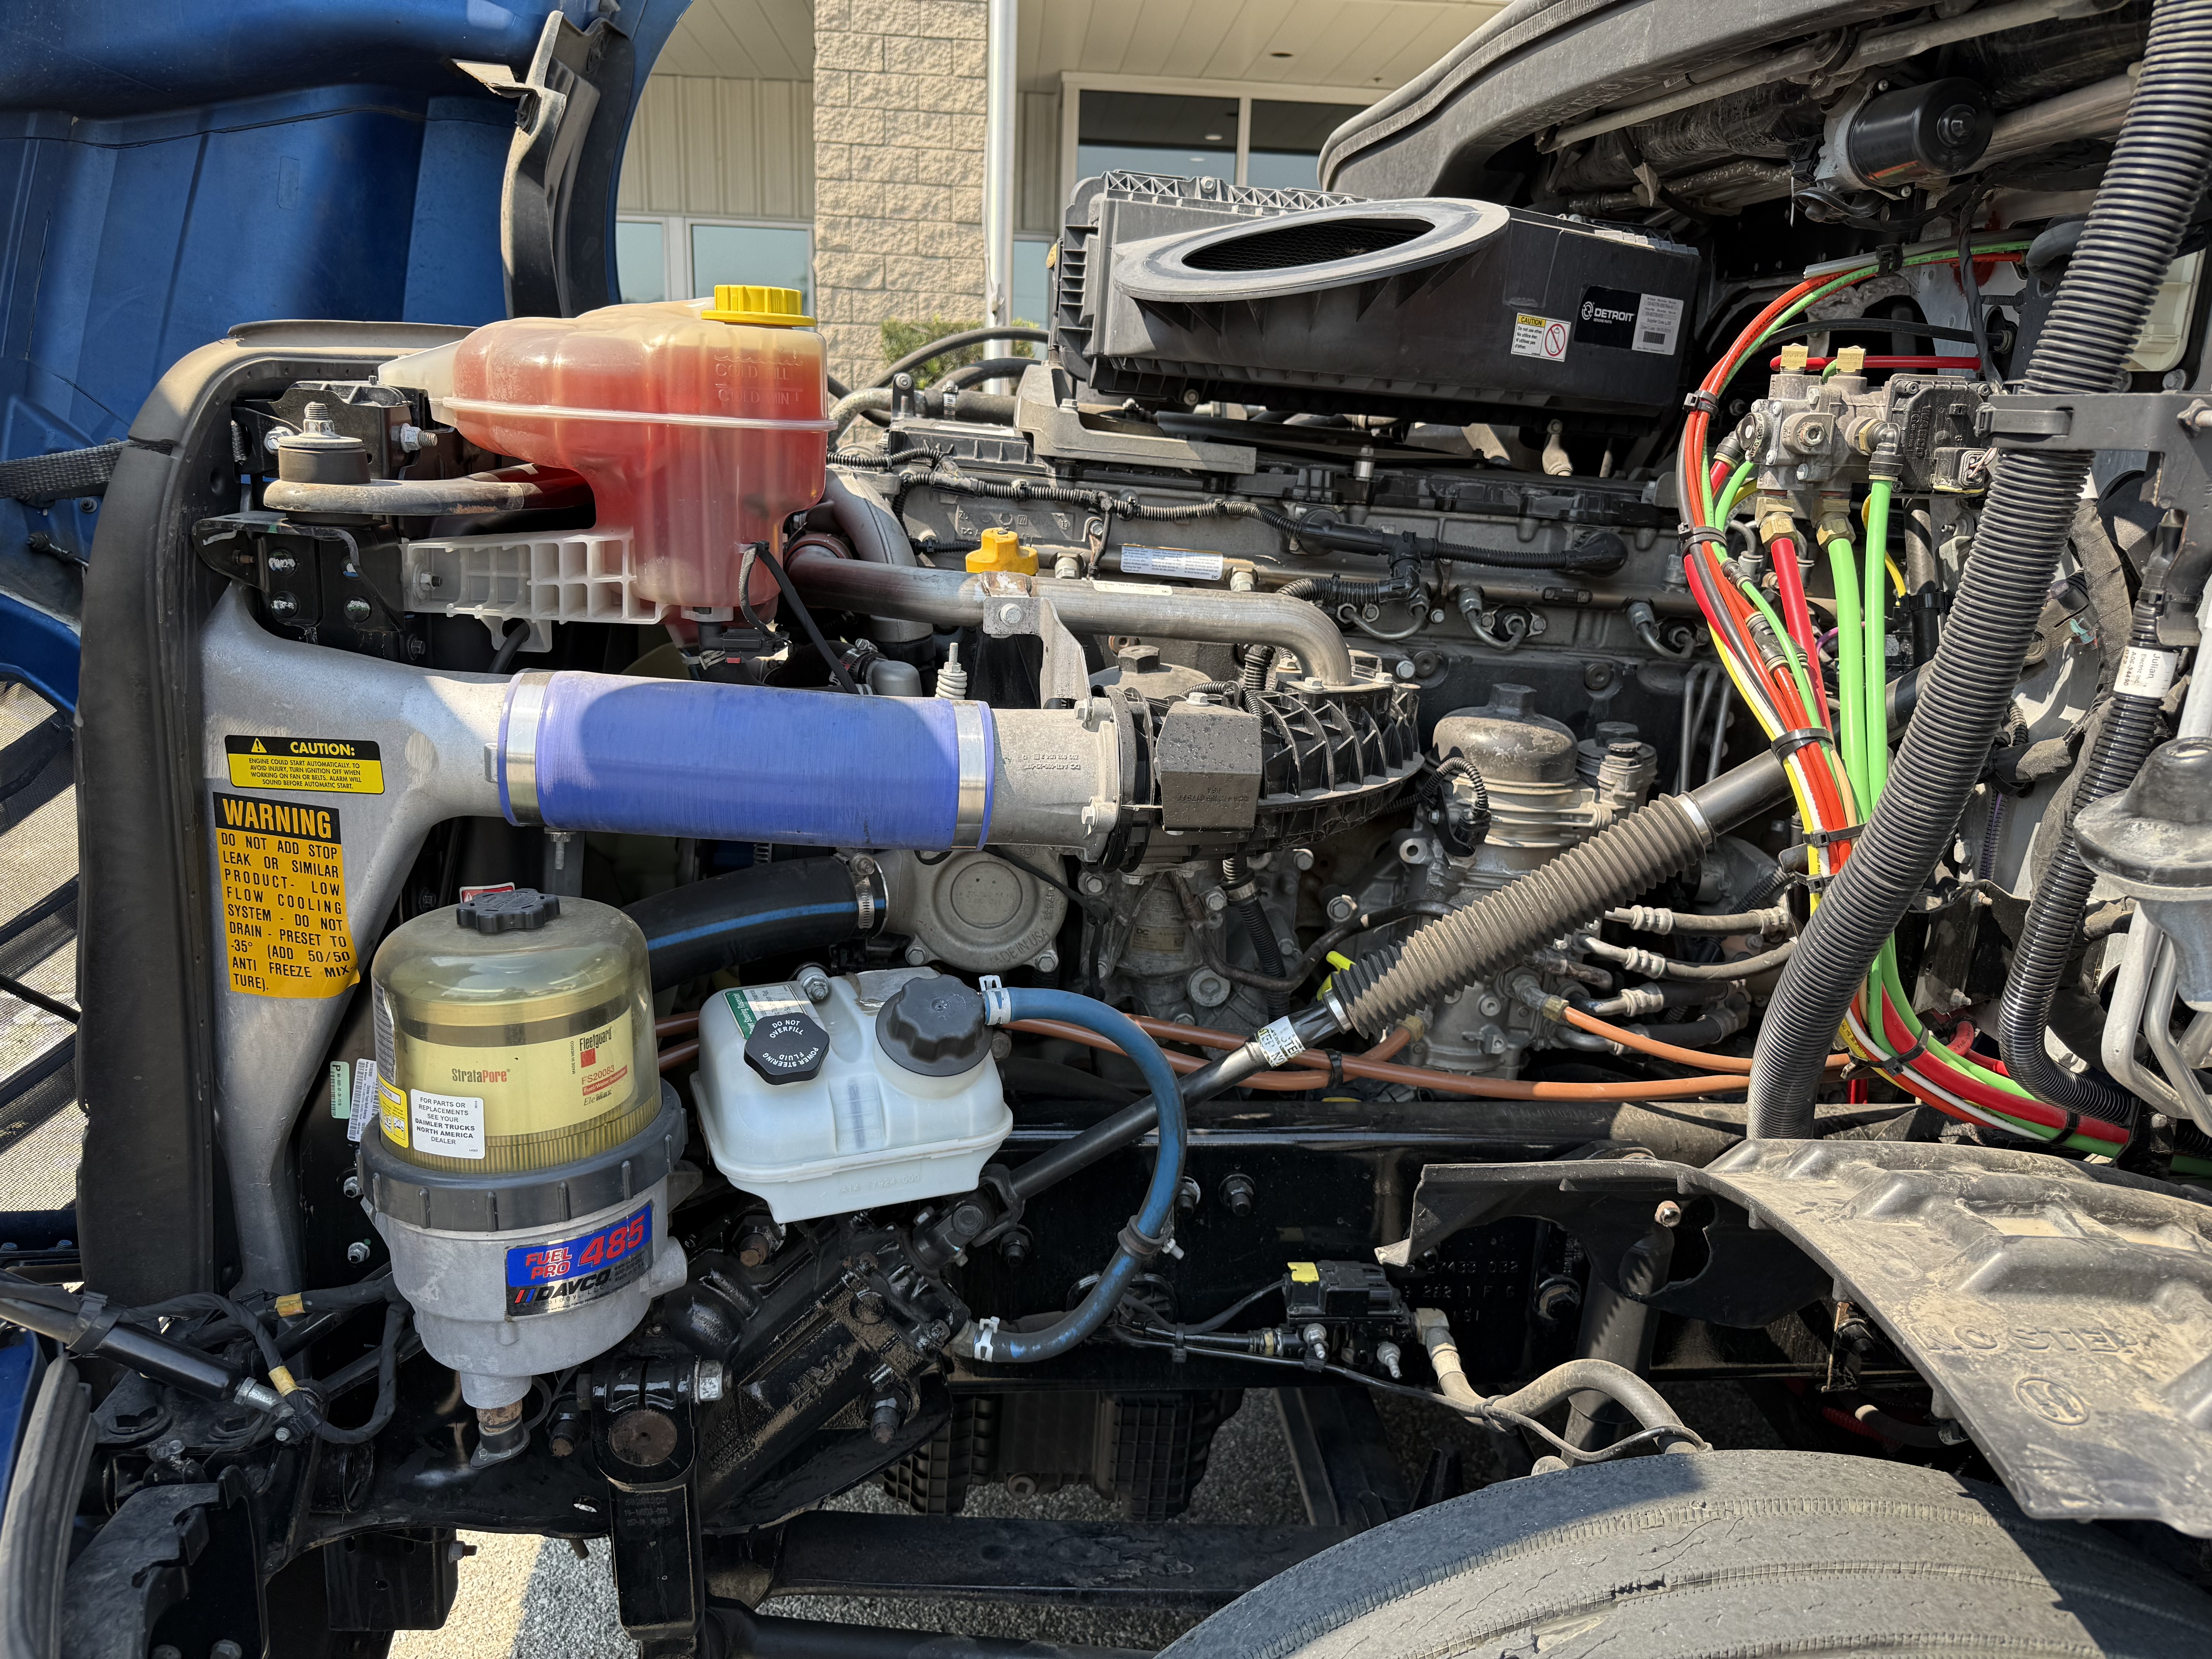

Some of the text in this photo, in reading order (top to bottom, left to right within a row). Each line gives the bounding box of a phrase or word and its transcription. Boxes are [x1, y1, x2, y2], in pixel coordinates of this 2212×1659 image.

[1521, 317, 1542, 326] CAUTION
[1594, 308, 1636, 322] DETROIT
[715, 363, 758, 379] COLD
[718, 389, 760, 404] COLD
[1916, 401, 1932, 459] WABCO
[2137, 654, 2147, 674] Electric
[2148, 653, 2160, 679] Julian
[290, 741, 355, 756] CAUTION:
[307, 761, 351, 769] AUTOMATICALLY.
[222, 798, 332, 839] WARNING
[222, 832, 337, 860] DO NOT ADD STOP
[223, 850, 339, 879] LEAK OR SIMILAR
[311, 880, 340, 896] LOW
[227, 886, 342, 915] FLOW COOLING
[228, 904, 271, 922] SYSTEM
[295, 914, 309, 927] DO
[321, 917, 343, 931] NOT
[230, 921, 262, 938] DRAIN
[280, 929, 321, 946] PRESET
[330, 935, 347, 948] TO
[268, 944, 294, 960] (ADD
[308, 950, 350, 963] 50/50
[991, 928, 1050, 966] ADE IN USA
[233, 957, 354, 978] ANTI FREEZE MIX-
[233, 973, 269, 993] TURE).
[732, 993, 746, 1009] Reservoir
[740, 1008, 752, 1023] Steering
[580, 1027, 612, 1051] Fleetguard
[769, 1026, 804, 1038] OVERFILL
[763, 1047, 819, 1067] POWER STEERING
[779, 1052, 804, 1061] FLUID
[581, 1065, 615, 1085] FS20083
[419, 1104, 469, 1115] REPLACEMENTS
[415, 1118, 443, 1128] DAIMLER
[417, 1126, 474, 1139] NORTH AMERICA
[578, 1214, 645, 1267] 485
[526, 1247, 572, 1266] FUEL
[531, 1261, 570, 1279] PRO
[535, 1269, 611, 1302] DAVCO
[588, 1285, 605, 1295] LLC
[1907, 1324, 2140, 1355] NO STEP
